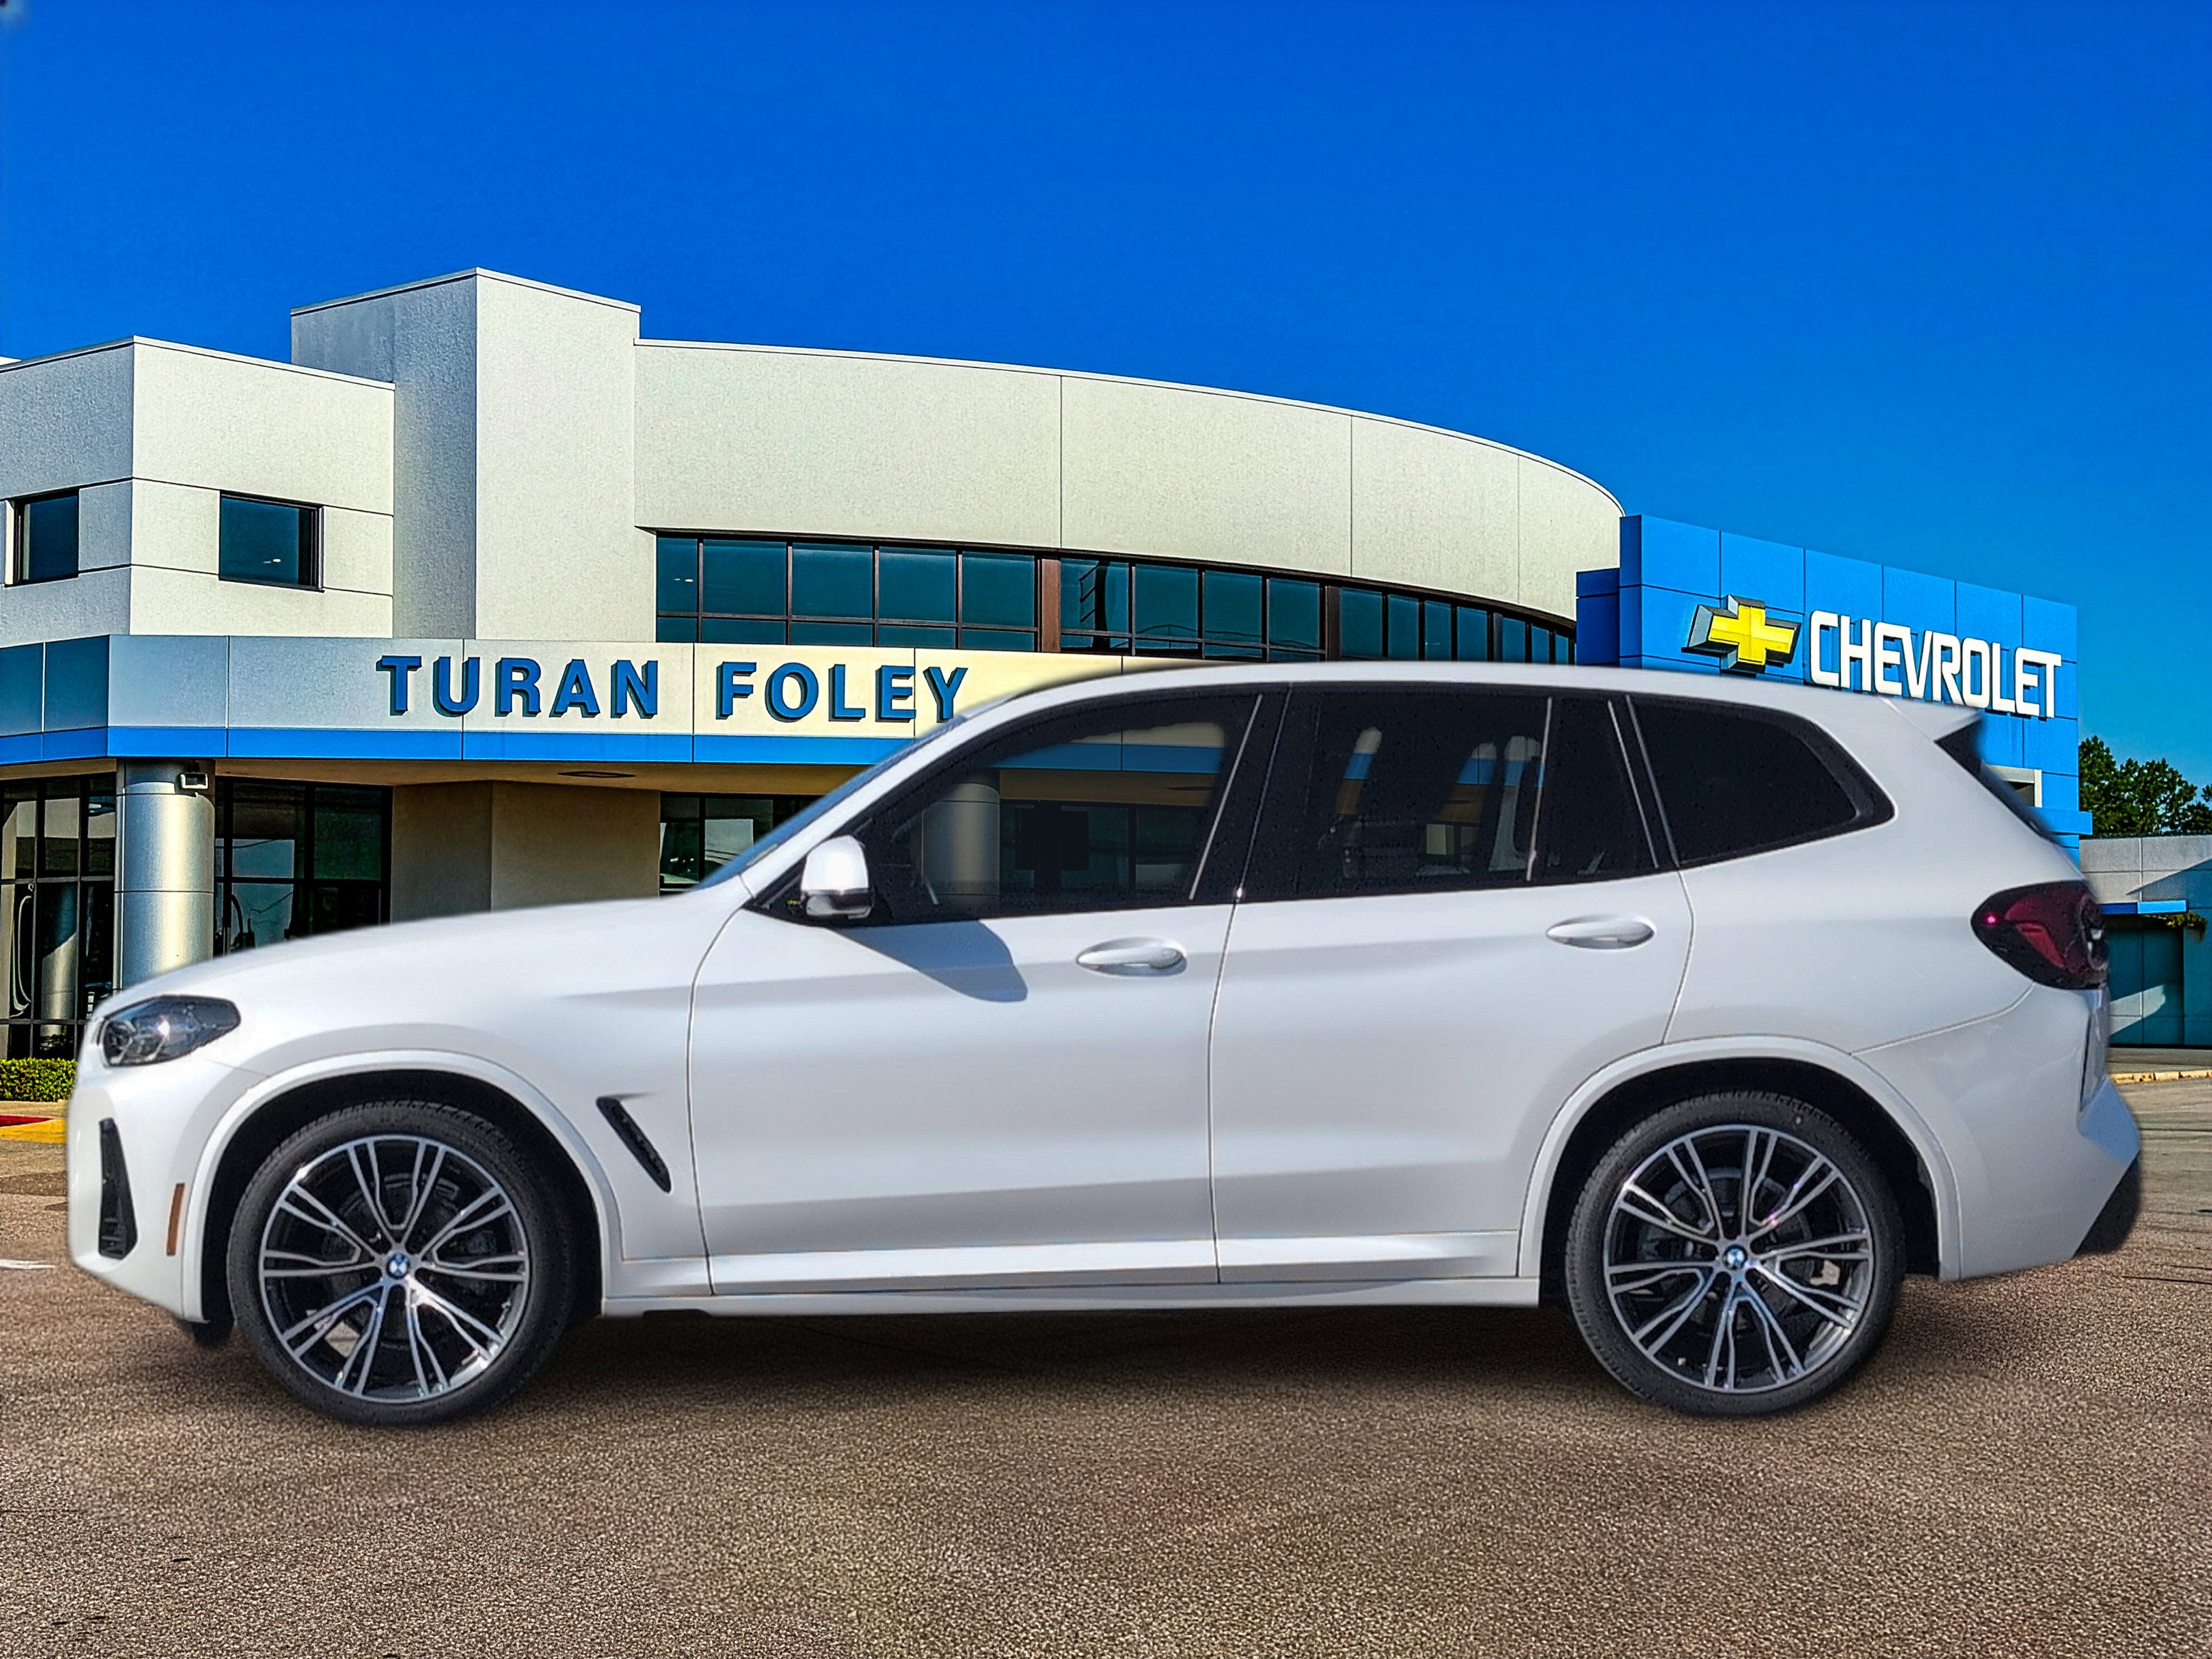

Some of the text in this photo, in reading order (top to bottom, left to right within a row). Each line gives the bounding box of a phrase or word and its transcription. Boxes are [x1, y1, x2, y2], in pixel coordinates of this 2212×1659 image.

[376, 655, 968, 723] TURAN FOLEY
[1809, 610, 2062, 718] CHEVROLET
